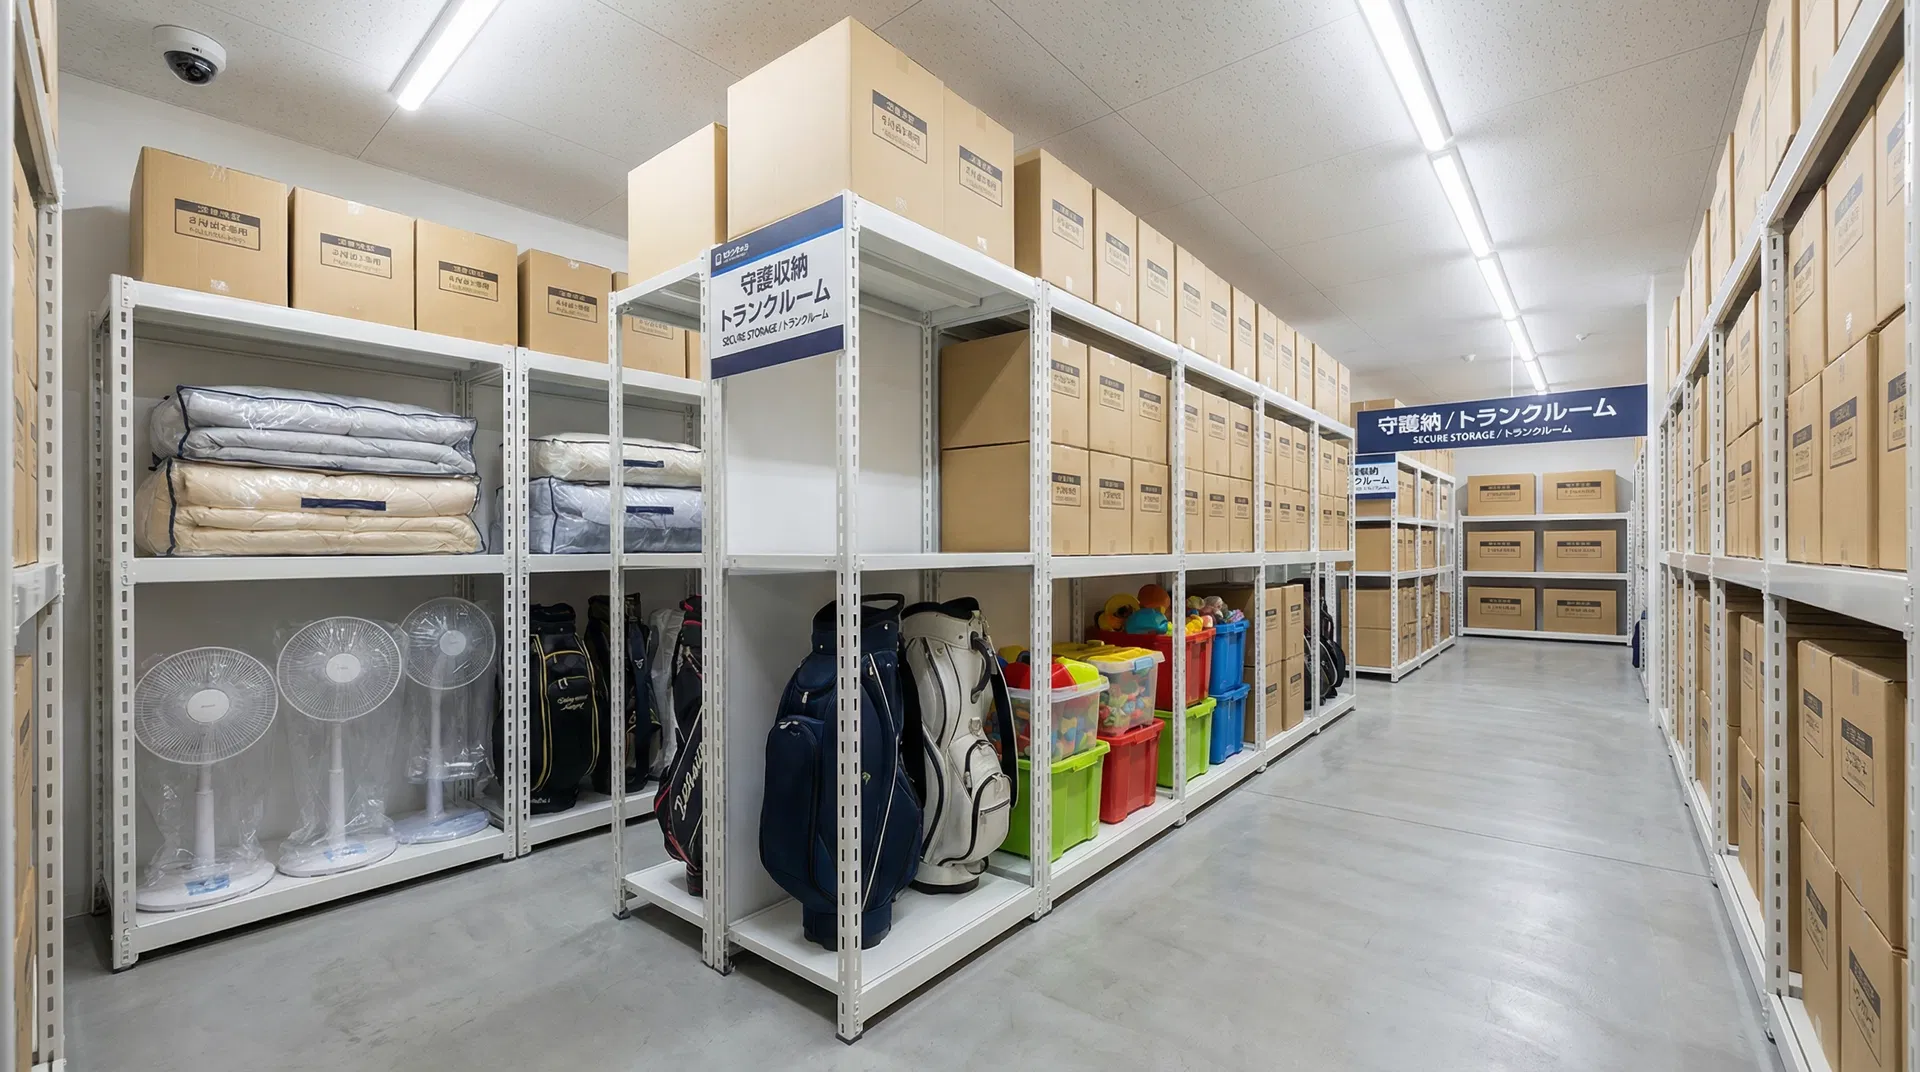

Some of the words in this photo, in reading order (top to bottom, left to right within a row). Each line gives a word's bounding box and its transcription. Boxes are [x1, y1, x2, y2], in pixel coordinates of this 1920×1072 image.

[740, 252, 808, 296] 守護収納
[721, 278, 831, 332] トランクルーム
[1460, 397, 1617, 429] トランクルーム
[1413, 433, 1449, 445] SECURE
[1450, 430, 1495, 442] STORAGE
[1505, 424, 1572, 438] トランクルーム
